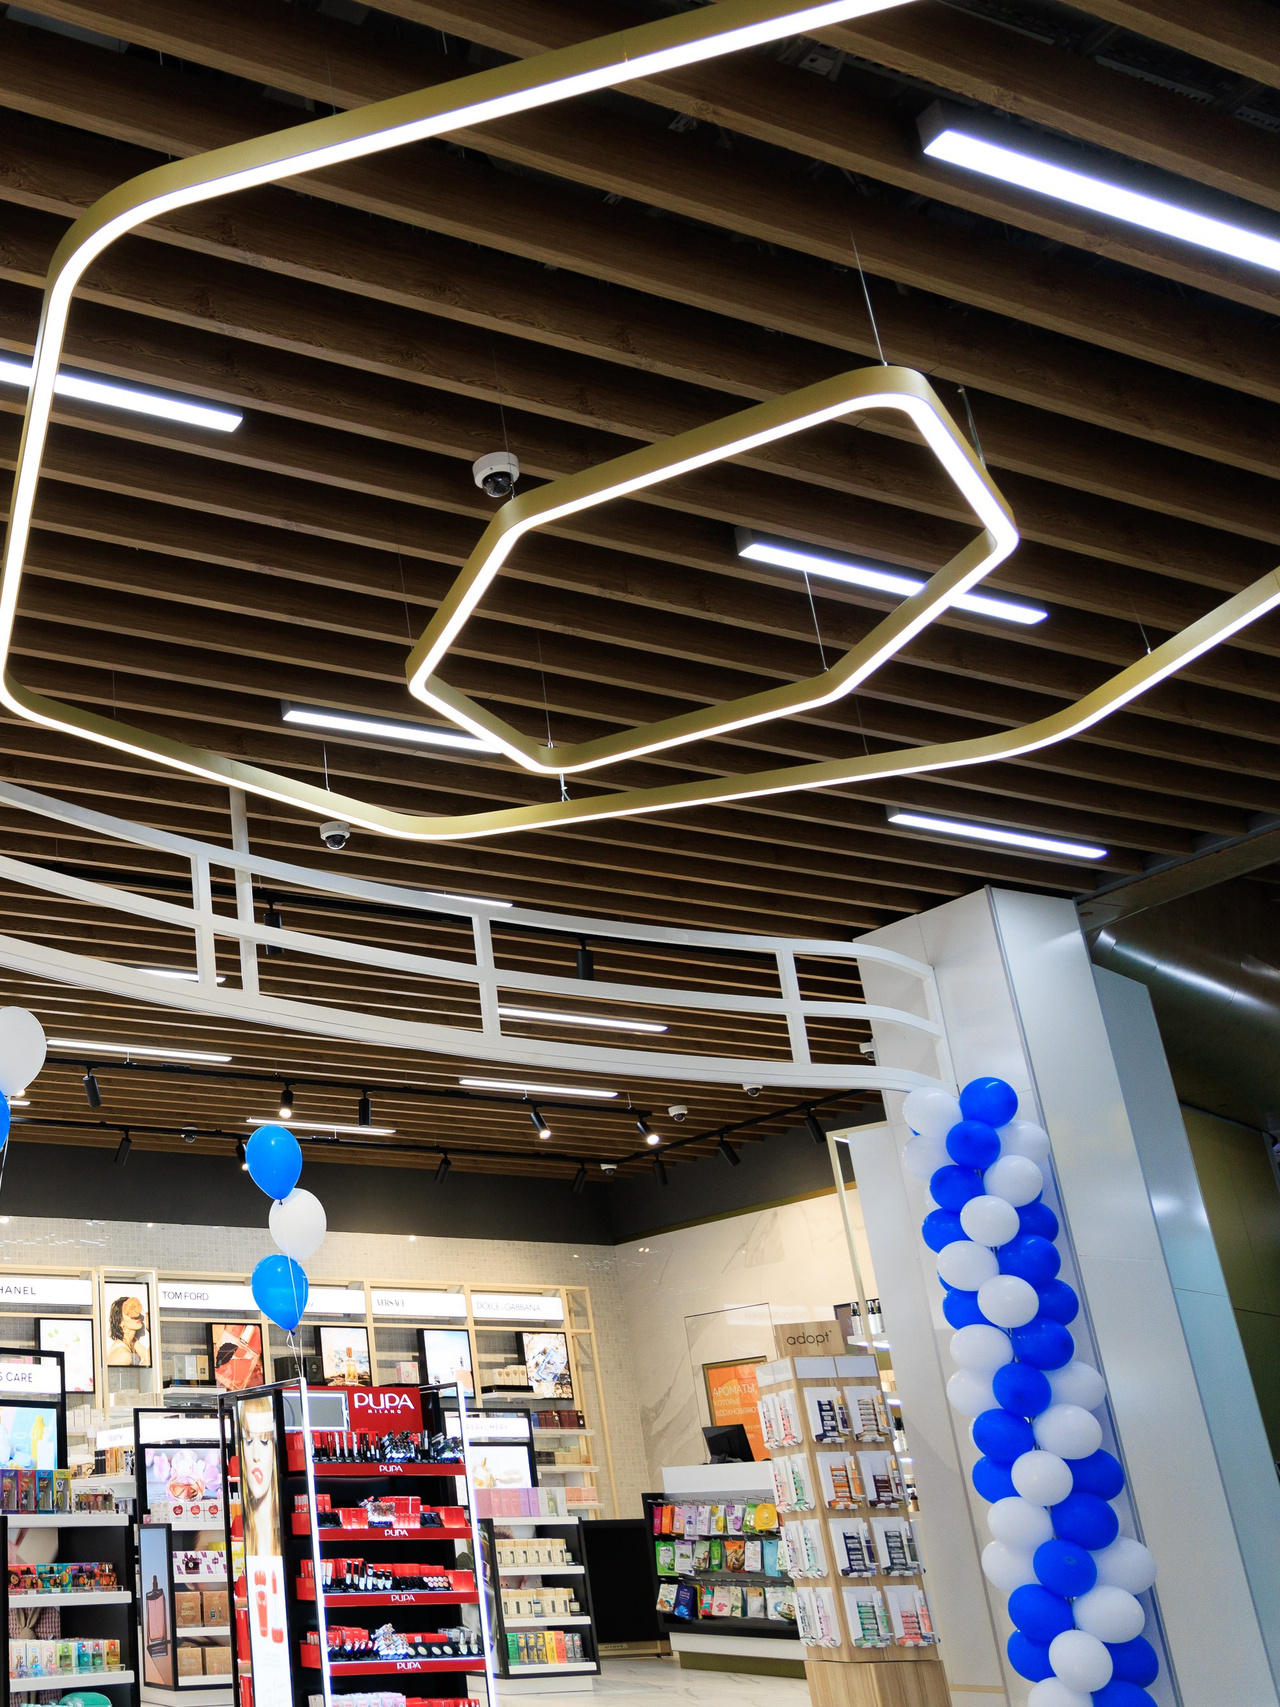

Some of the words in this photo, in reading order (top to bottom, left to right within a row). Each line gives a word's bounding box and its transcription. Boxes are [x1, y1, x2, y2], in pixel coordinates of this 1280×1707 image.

[162, 1291, 182, 1300] TOM
[184, 1292, 209, 1302] FORD
[377, 1298, 405, 1307] VERSACE
[505, 1303, 541, 1312] GABBANA
[5, 1371, 33, 1383] CARE
[713, 1382, 758, 1397] АРОМАТЫ,
[353, 1392, 415, 1409] PUPA
[379, 1464, 403, 1472] PUPA
[384, 1529, 409, 1537] PUPA
[391, 1594, 416, 1602] PUPA
[396, 1662, 422, 1670] PUPA
